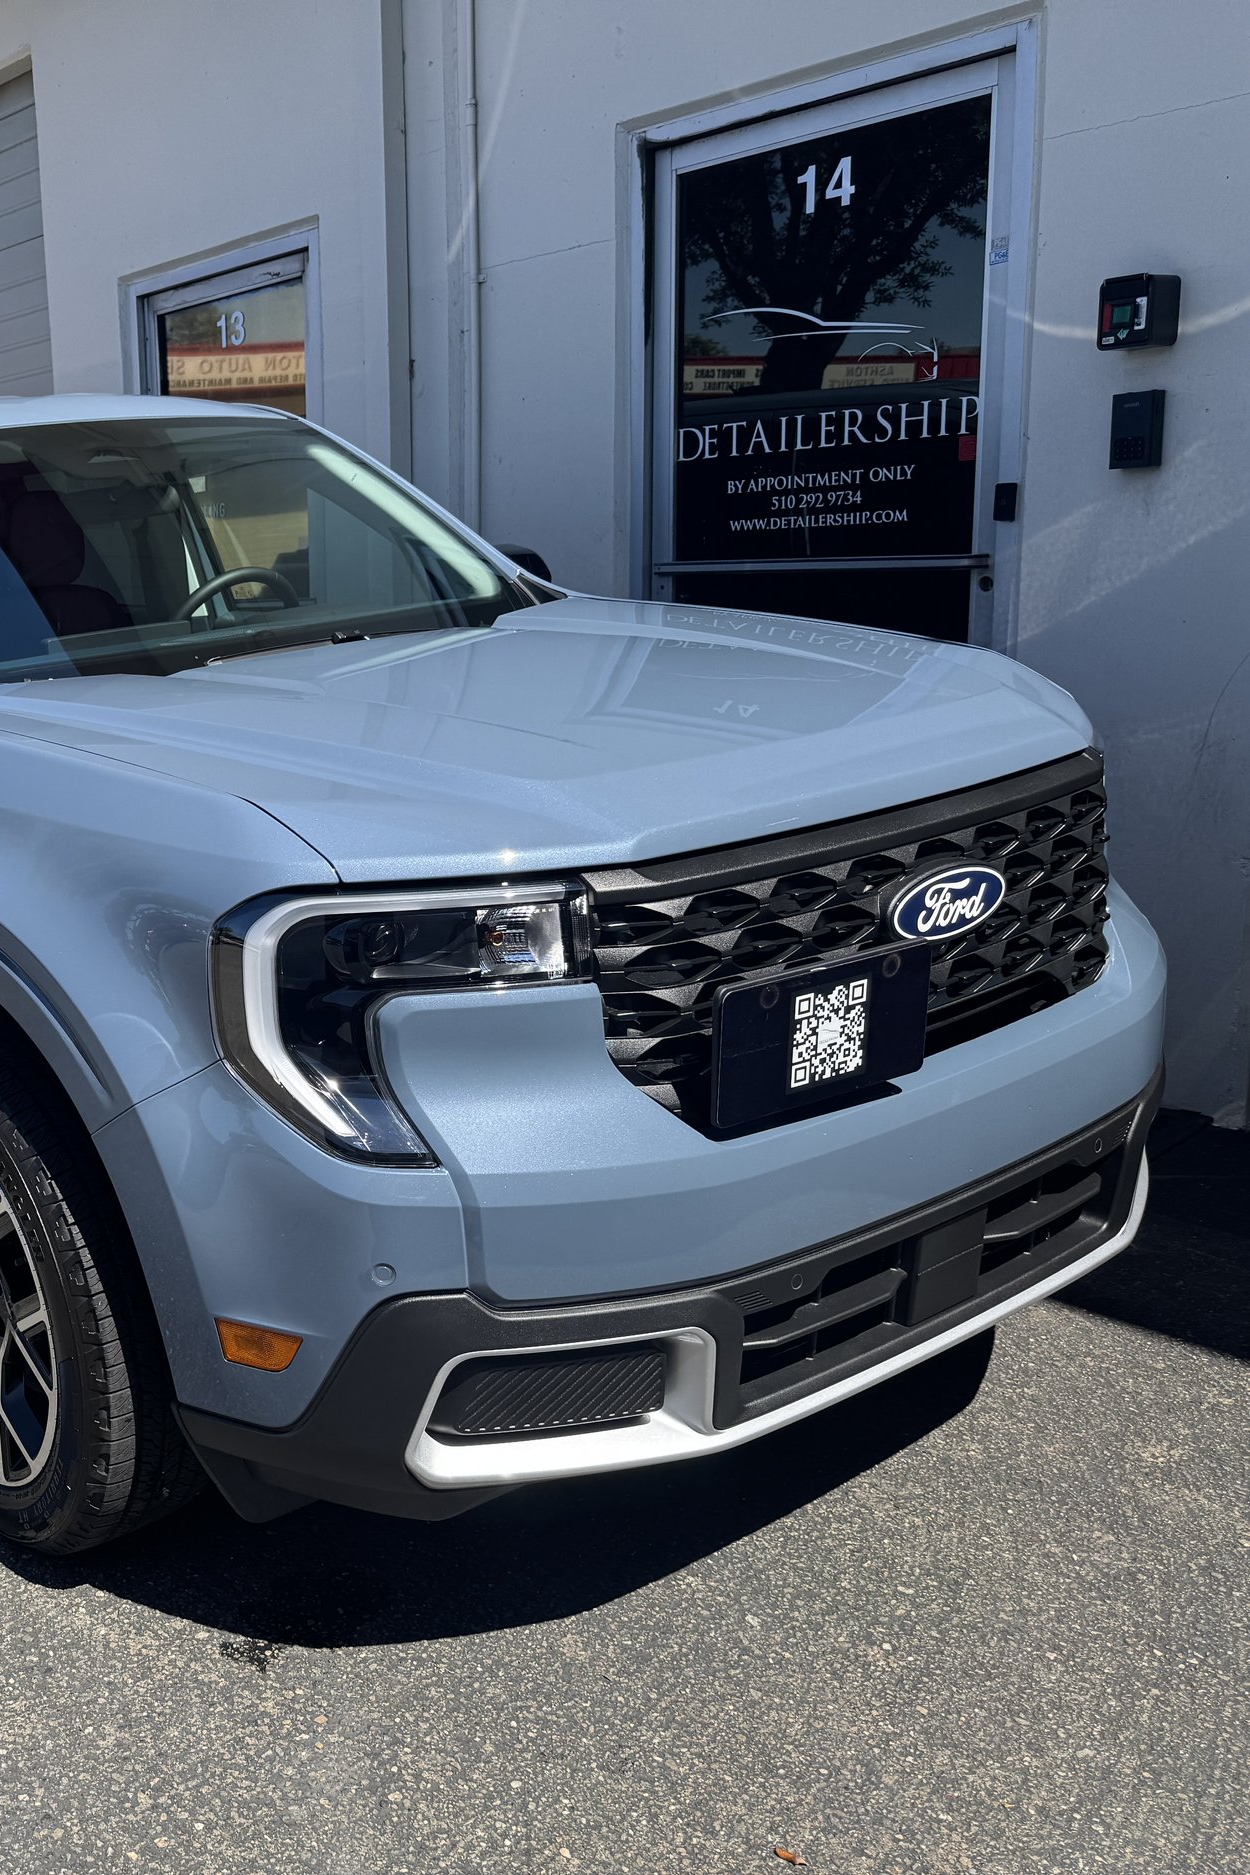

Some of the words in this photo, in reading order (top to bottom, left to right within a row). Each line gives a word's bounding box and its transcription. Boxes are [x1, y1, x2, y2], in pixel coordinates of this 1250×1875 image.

[797, 155, 856, 214] 14
[217, 310, 246, 348] 13
[677, 395, 980, 462] DETAILERSHIP
[727, 480, 746, 494] BY
[747, 469, 864, 493] APPOINTMENT
[869, 464, 916, 482] ONLY
[771, 494, 796, 511] 510
[799, 492, 825, 509] 292
[827, 490, 863, 507] 9734
[729, 508, 909, 532] WWW.DETAILERSHIP.COM
[917, 878, 987, 932] Ford
